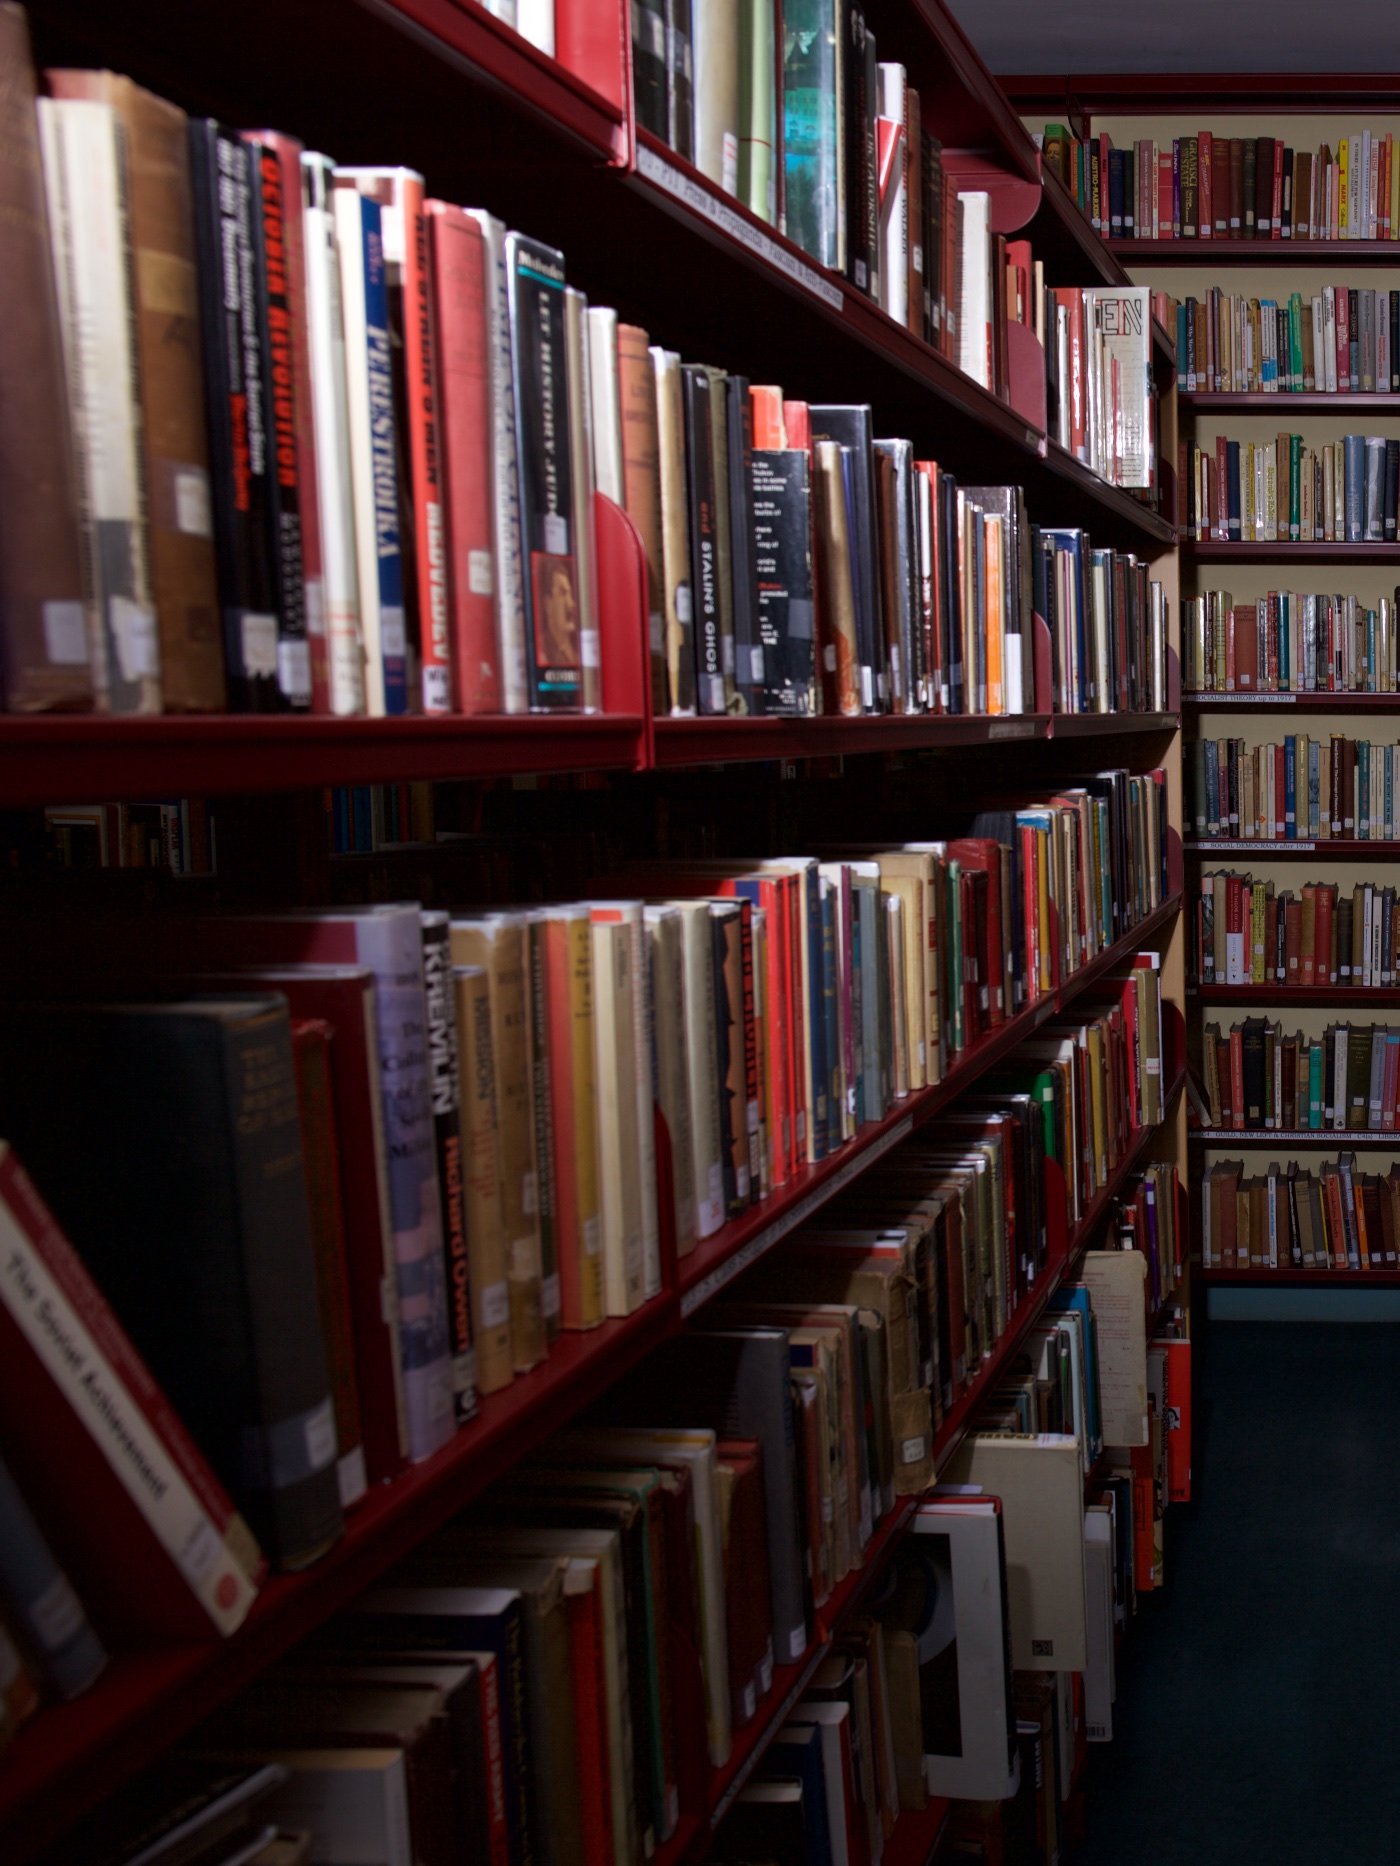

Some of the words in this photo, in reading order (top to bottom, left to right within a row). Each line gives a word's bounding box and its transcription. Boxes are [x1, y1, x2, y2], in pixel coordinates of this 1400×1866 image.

[866, 131, 876, 252] DICTATORSHIP
[1189, 139, 1198, 188] GRAMSCI
[260, 155, 287, 296] OCTOBER
[538, 289, 551, 337] LET
[268, 305, 296, 489] REVOLUTION
[366, 324, 400, 558] PERESTROIKA
[540, 341, 556, 455] HISTORY
[700, 501, 711, 534] and
[700, 540, 715, 615] STALIN'S
[426, 501, 449, 660] MEDVEDEV
[423, 940, 453, 1117] KREMLIN
[443, 1136, 466, 1258] Richard
[450, 1260, 472, 1354] Owen
[33, 1300, 87, 1371] Soviet
[79, 1370, 169, 1502] Achievement
